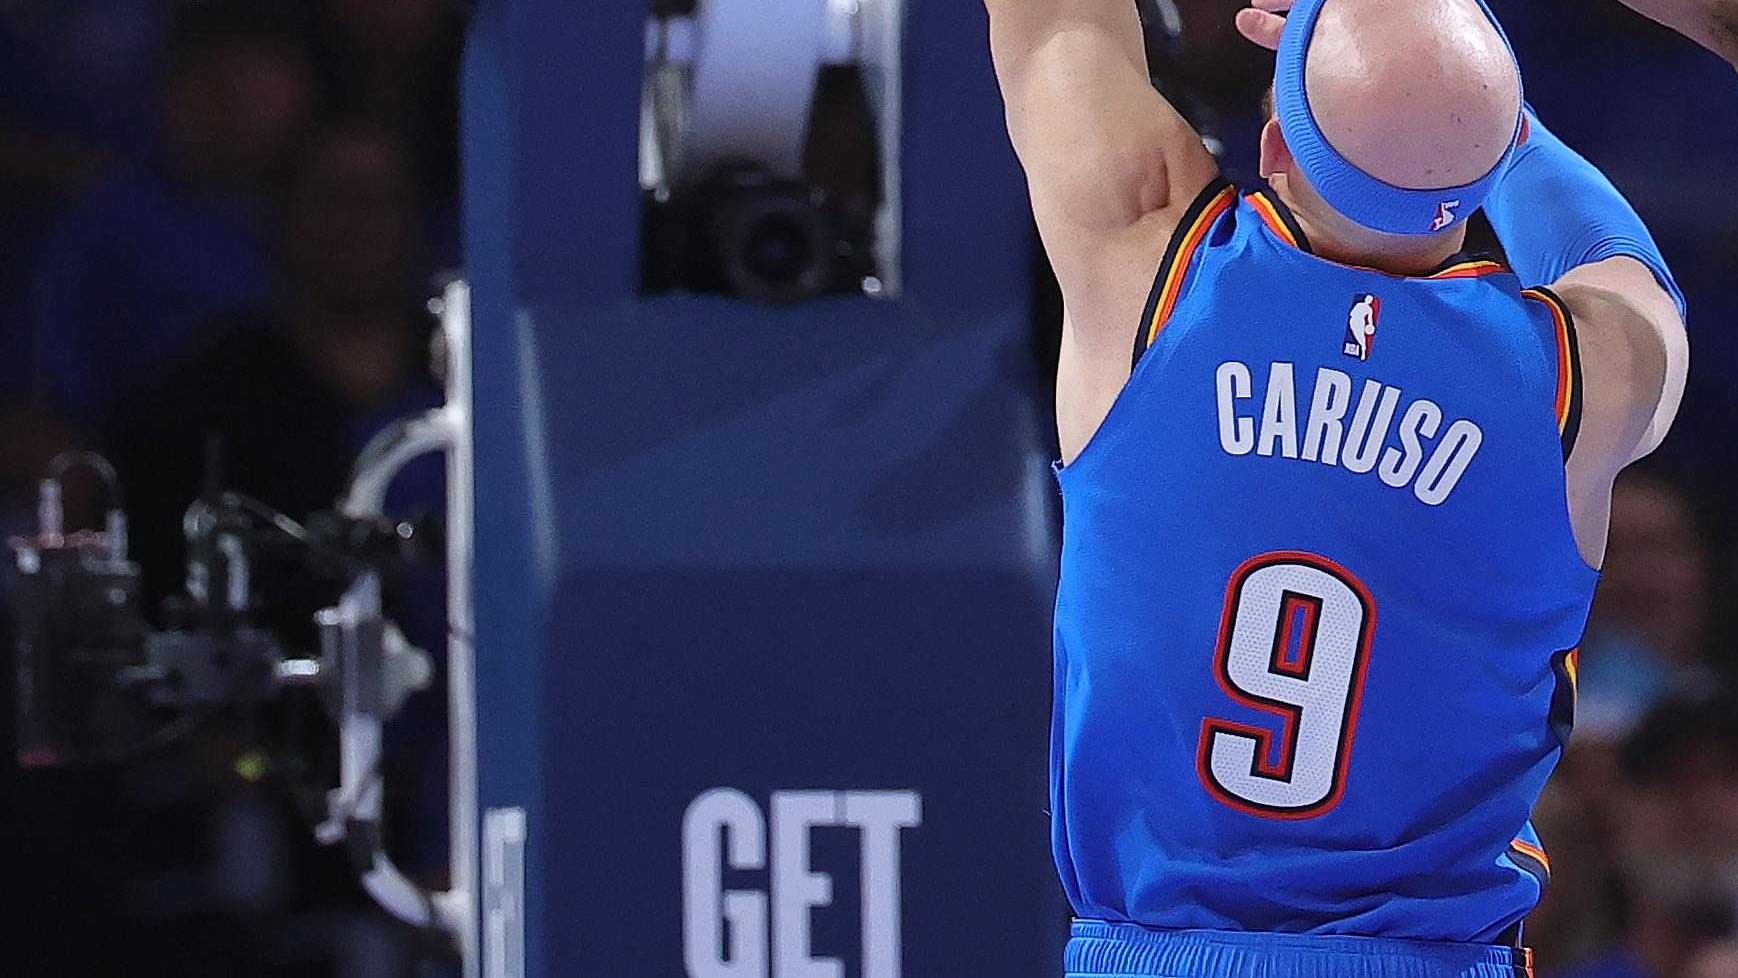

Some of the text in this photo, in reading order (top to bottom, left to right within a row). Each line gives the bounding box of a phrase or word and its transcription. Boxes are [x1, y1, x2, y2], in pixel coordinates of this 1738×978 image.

[1215, 360, 1484, 507] CARUSO
[1195, 550, 1378, 822] 9
[681, 786, 923, 978] GET
